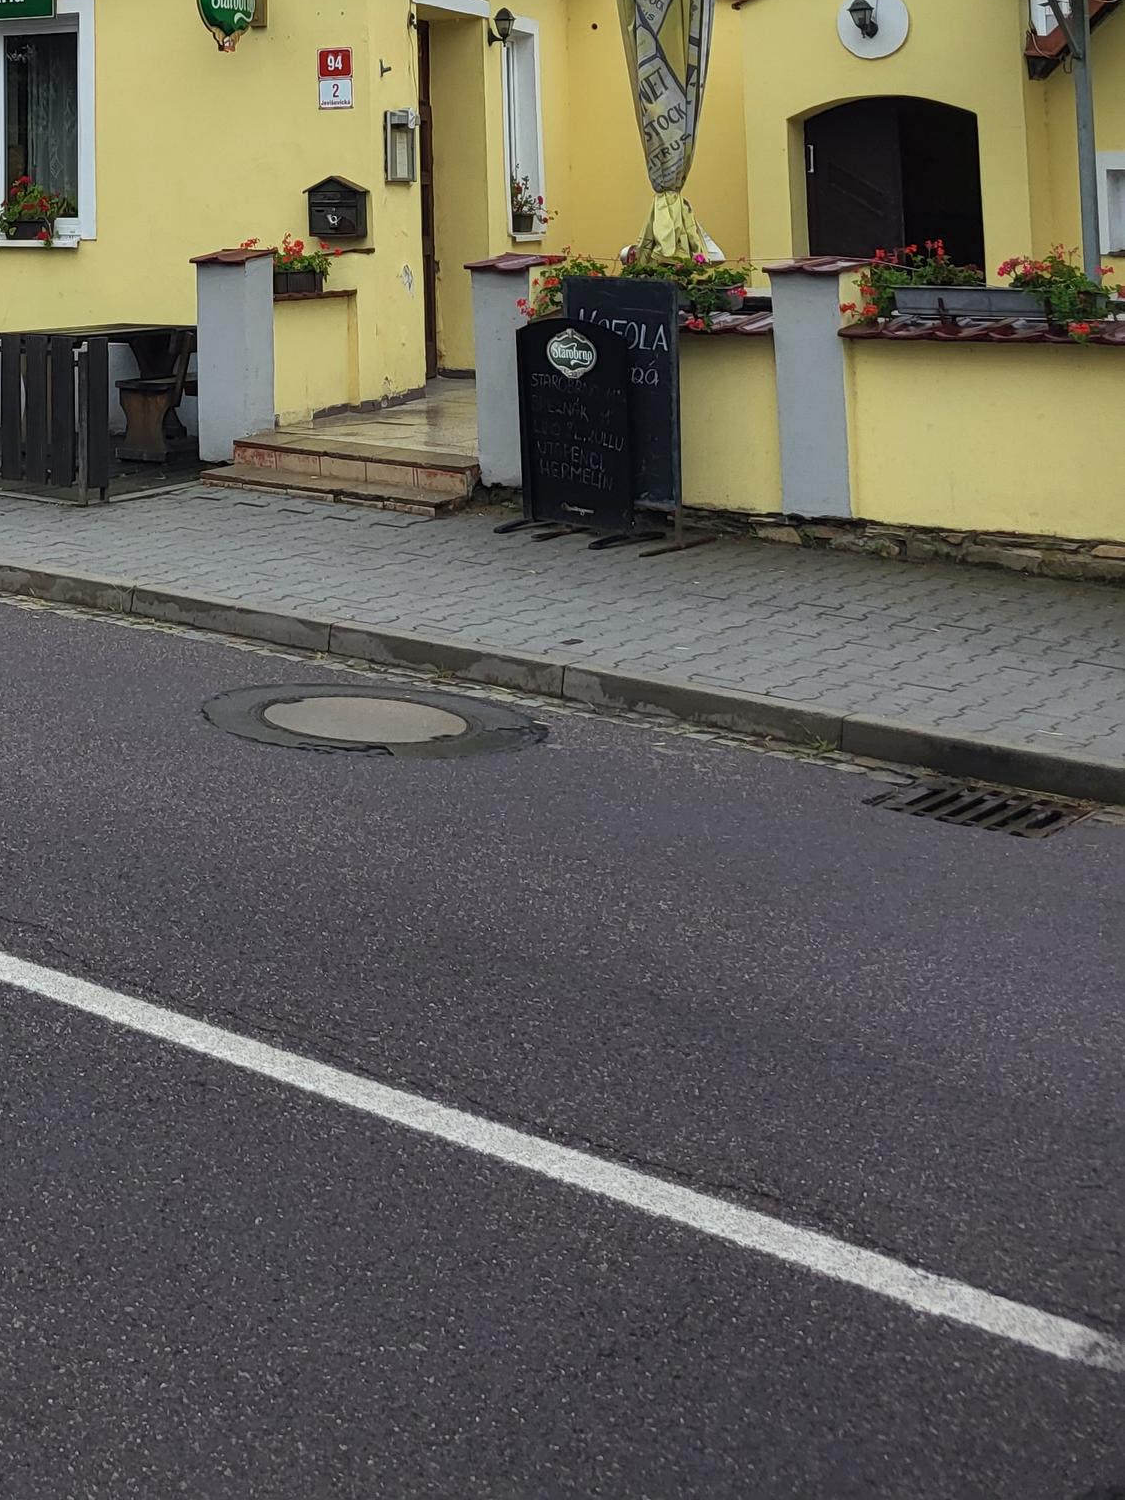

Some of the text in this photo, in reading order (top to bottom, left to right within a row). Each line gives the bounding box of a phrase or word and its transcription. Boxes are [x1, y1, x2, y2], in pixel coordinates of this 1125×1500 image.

[327, 55, 343, 71] 94
[332, 83, 340, 98] 2
[551, 341, 592, 366] Starobrno
